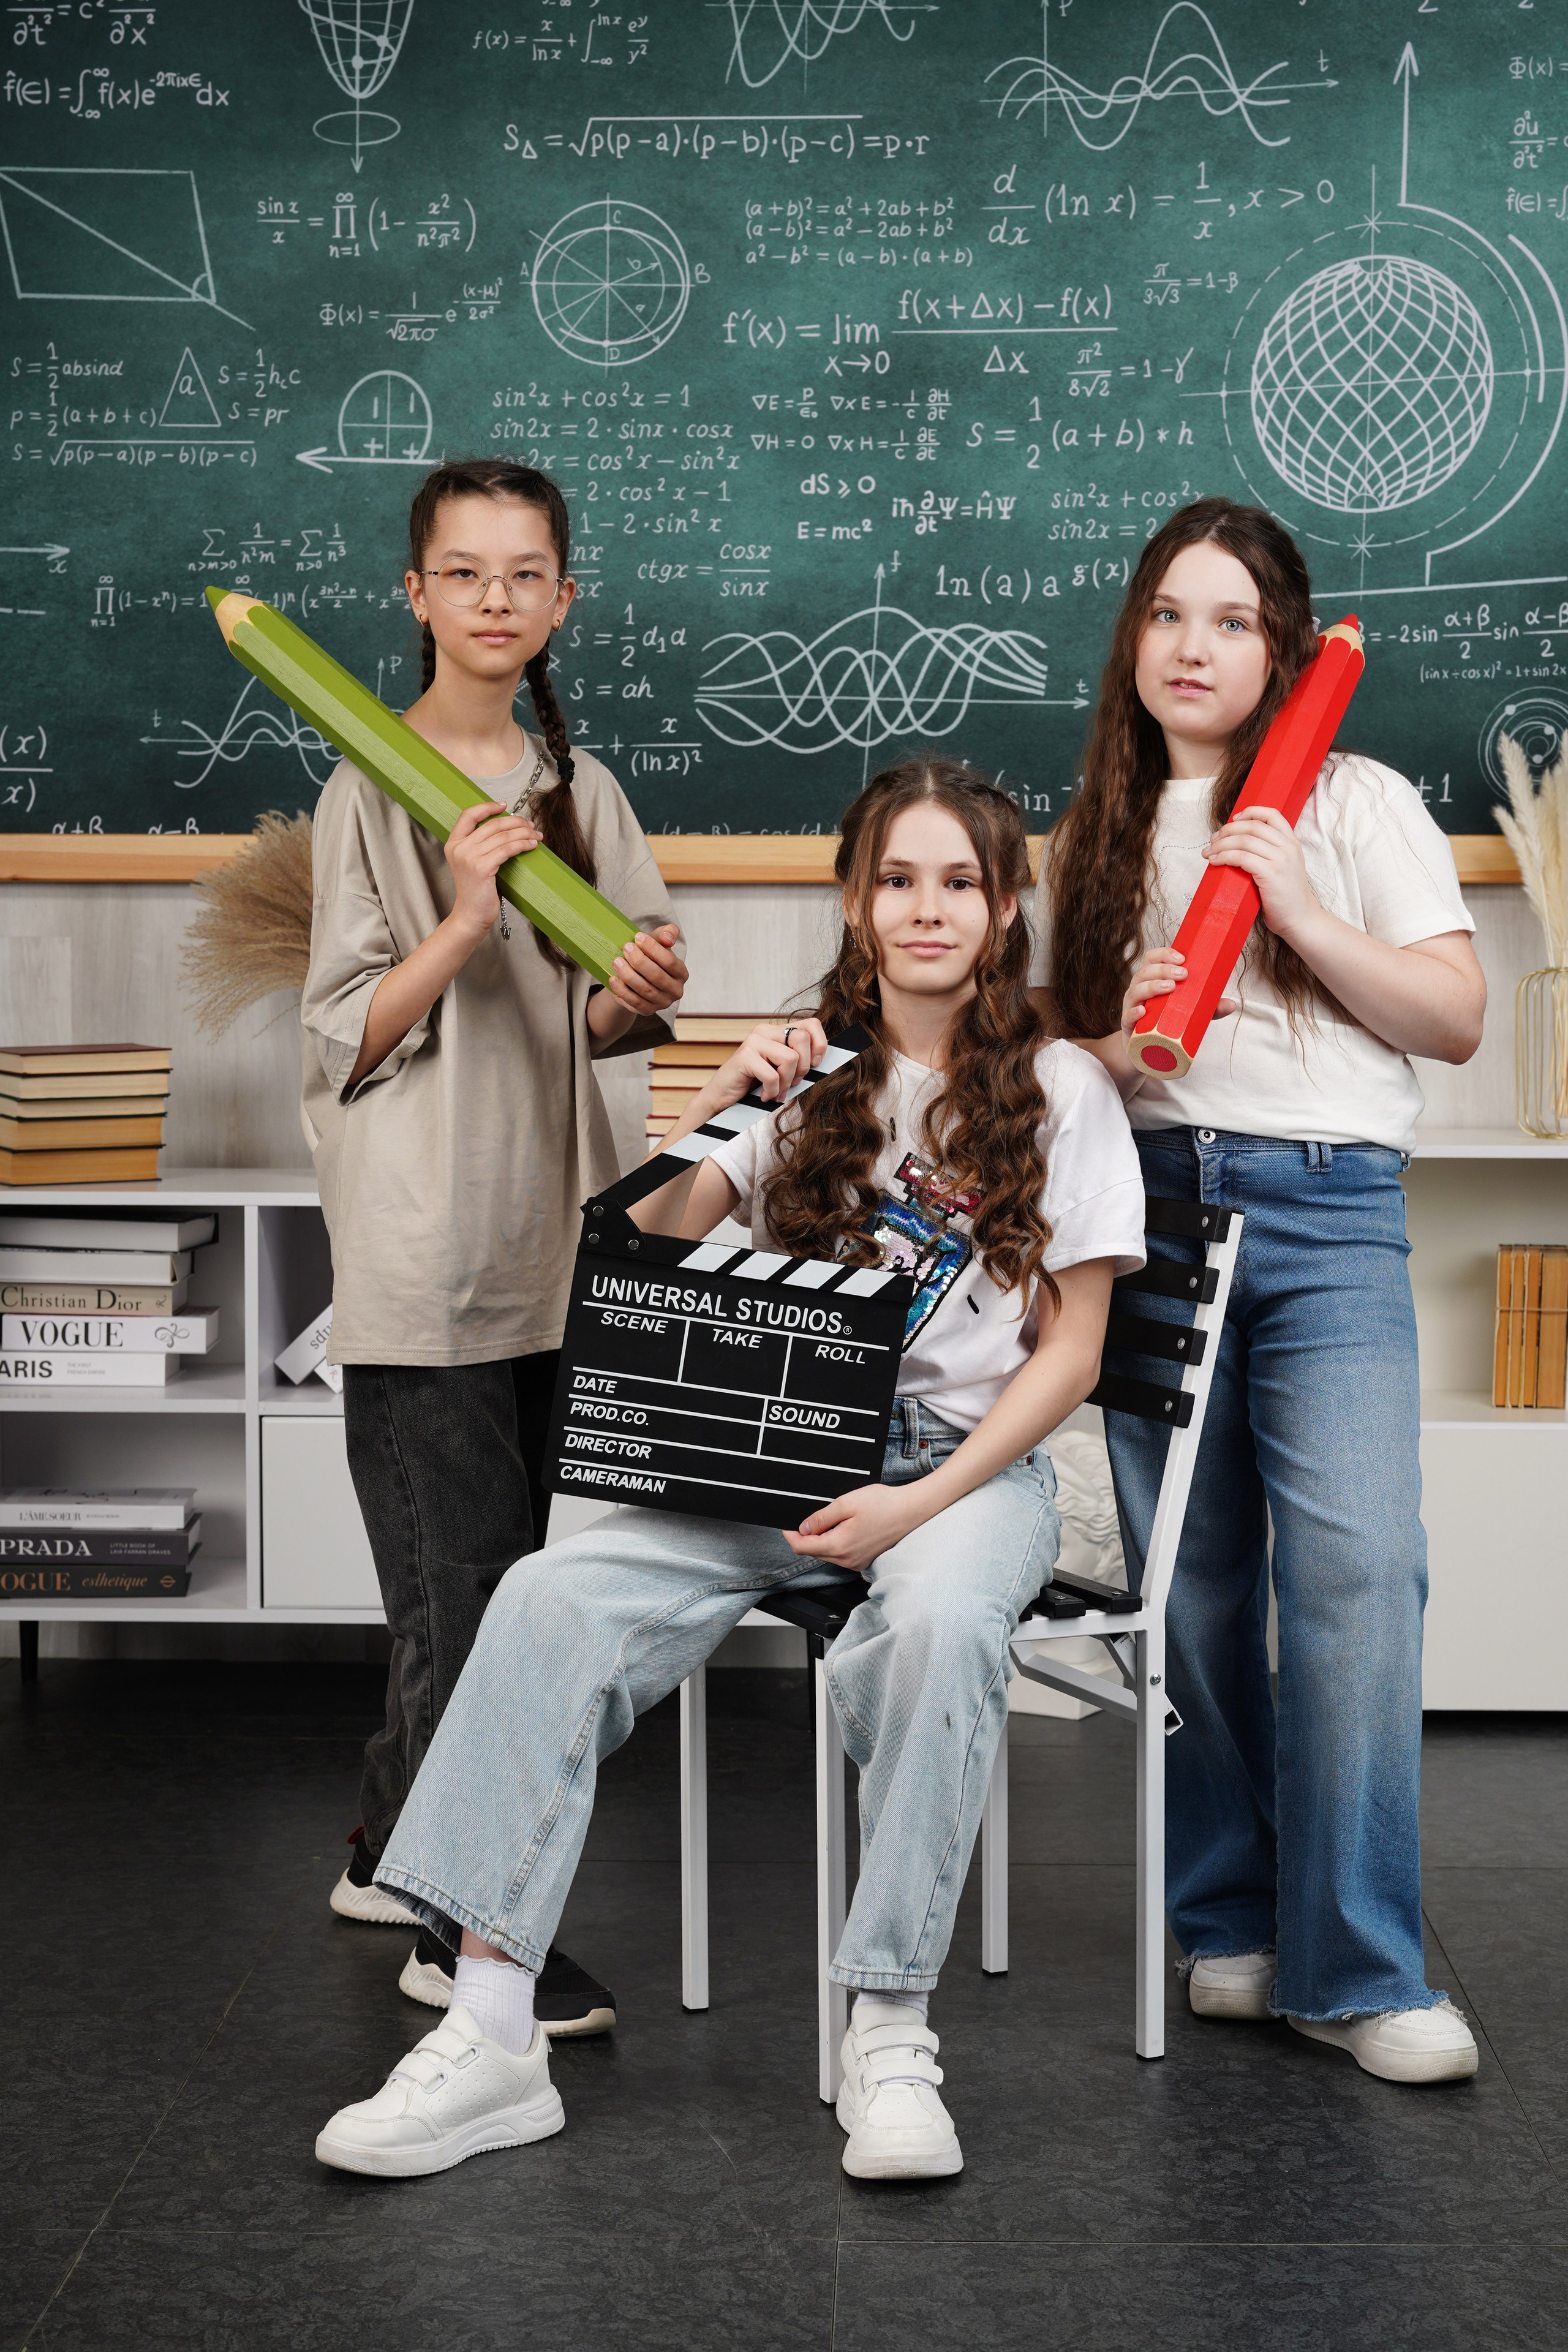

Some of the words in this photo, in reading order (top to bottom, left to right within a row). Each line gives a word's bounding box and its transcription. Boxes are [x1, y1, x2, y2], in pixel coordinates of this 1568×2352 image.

[832, 313, 880, 345] lim
[490, 417, 552, 439] sin2x
[617, 418, 665, 440] sinx
[686, 423, 734, 439] cosx
[1047, 518, 1110, 540] sin2x
[720, 543, 772, 560] cosx
[637, 559, 689, 584] ctgx
[719, 577, 770, 597] sinx
[1, 1286, 86, 1308] Christian
[96, 1289, 142, 1311] Dior
[592, 1275, 728, 1317] UNIVERSAL
[20, 1320, 123, 1348] VOGUE
[601, 1311, 668, 1335] SCENE
[712, 1329, 763, 1349] TAKE
[815, 1344, 866, 1365] ROLL
[573, 1375, 617, 1393] DATE
[570, 1401, 649, 1426] PROD.CO.
[769, 1405, 840, 1430] SOUND
[565, 1434, 652, 1460] DIRECTOR
[560, 1466, 666, 1493] CAMERAMAN
[1, 1539, 92, 1556] PRADA
